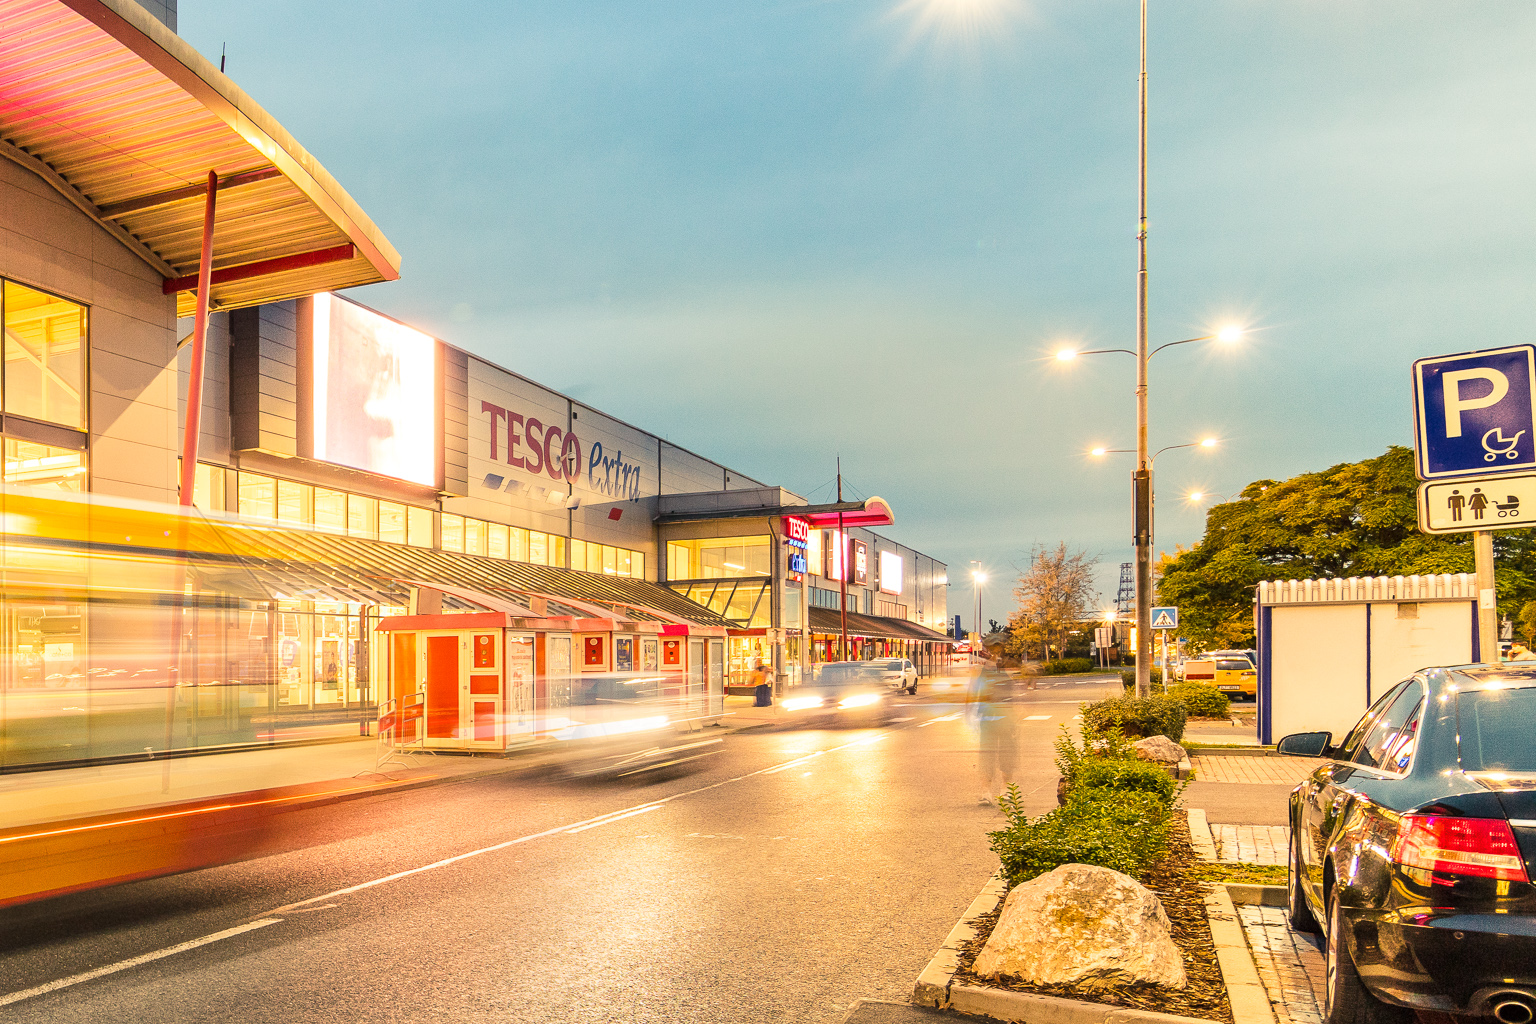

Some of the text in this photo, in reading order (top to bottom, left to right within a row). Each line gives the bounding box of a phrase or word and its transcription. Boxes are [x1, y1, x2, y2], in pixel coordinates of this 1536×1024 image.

[1441, 366, 1510, 439] P
[481, 399, 641, 504] TESCO extra
[788, 516, 809, 541] TESCO
